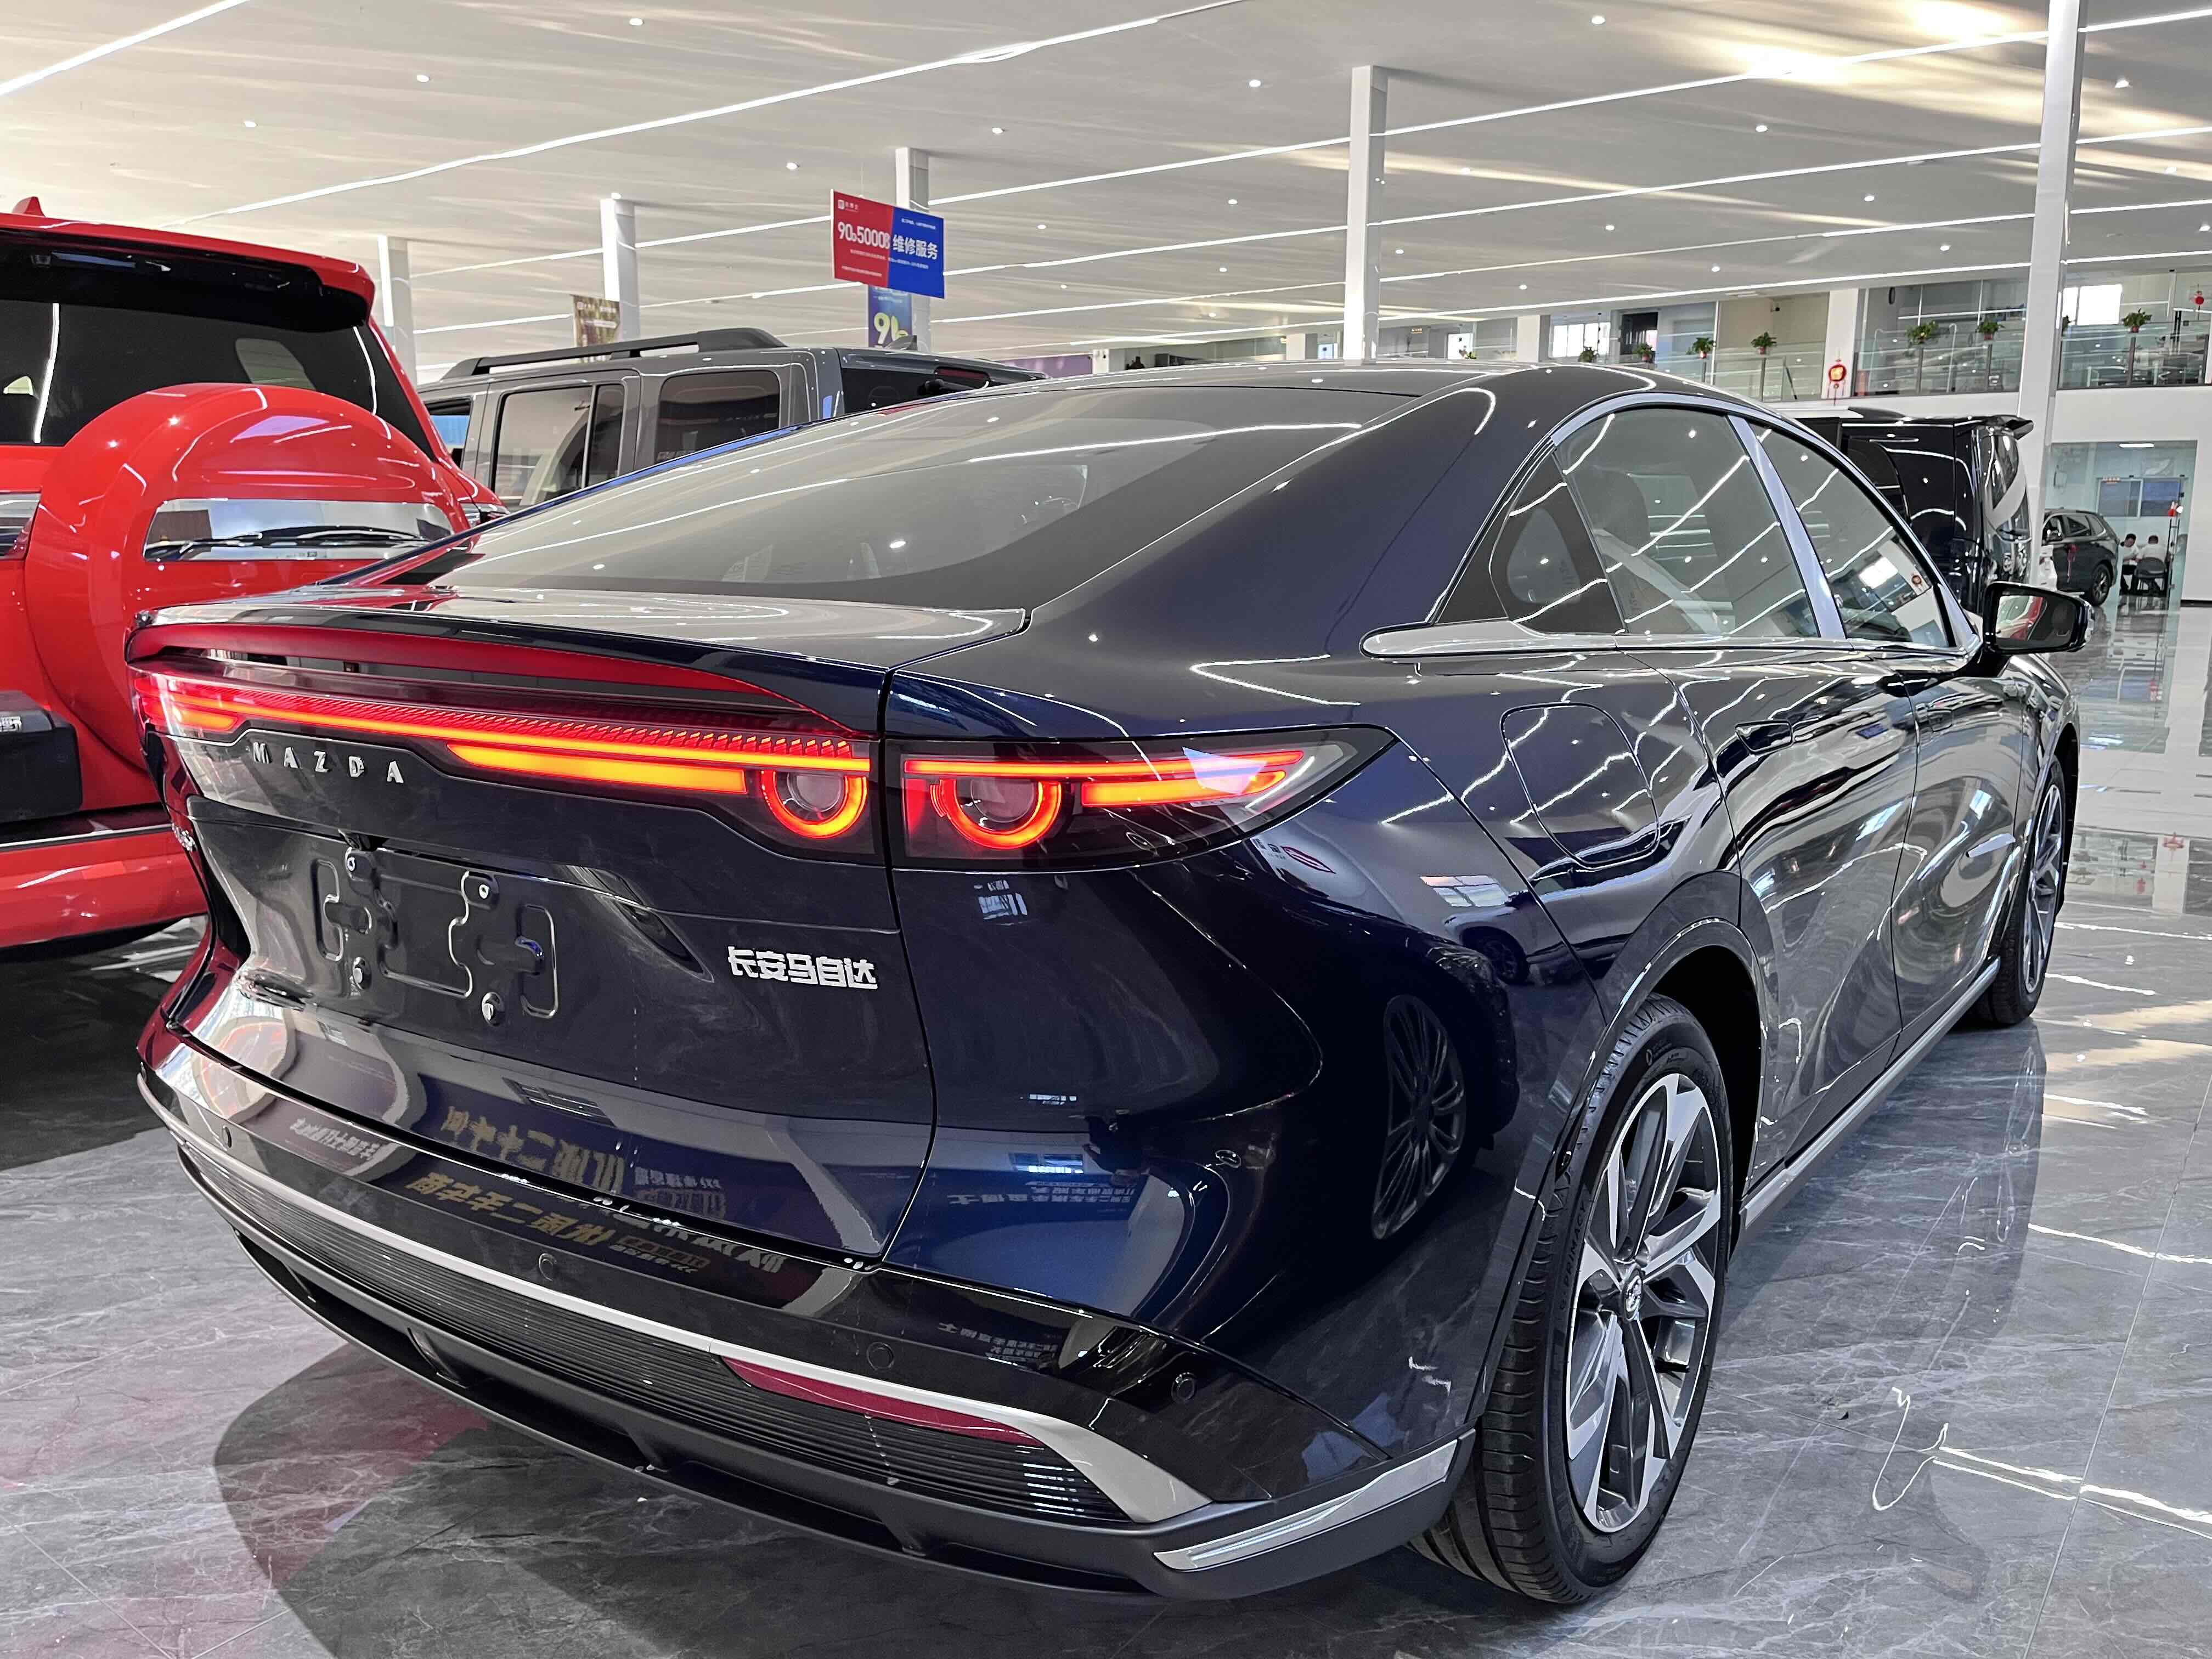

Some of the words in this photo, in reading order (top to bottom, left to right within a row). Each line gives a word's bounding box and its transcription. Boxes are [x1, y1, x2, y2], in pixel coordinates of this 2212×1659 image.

[893, 234, 938, 260] 维修服务
[252, 742, 404, 784] MAZDA
[727, 946, 878, 990] 长安马自达
